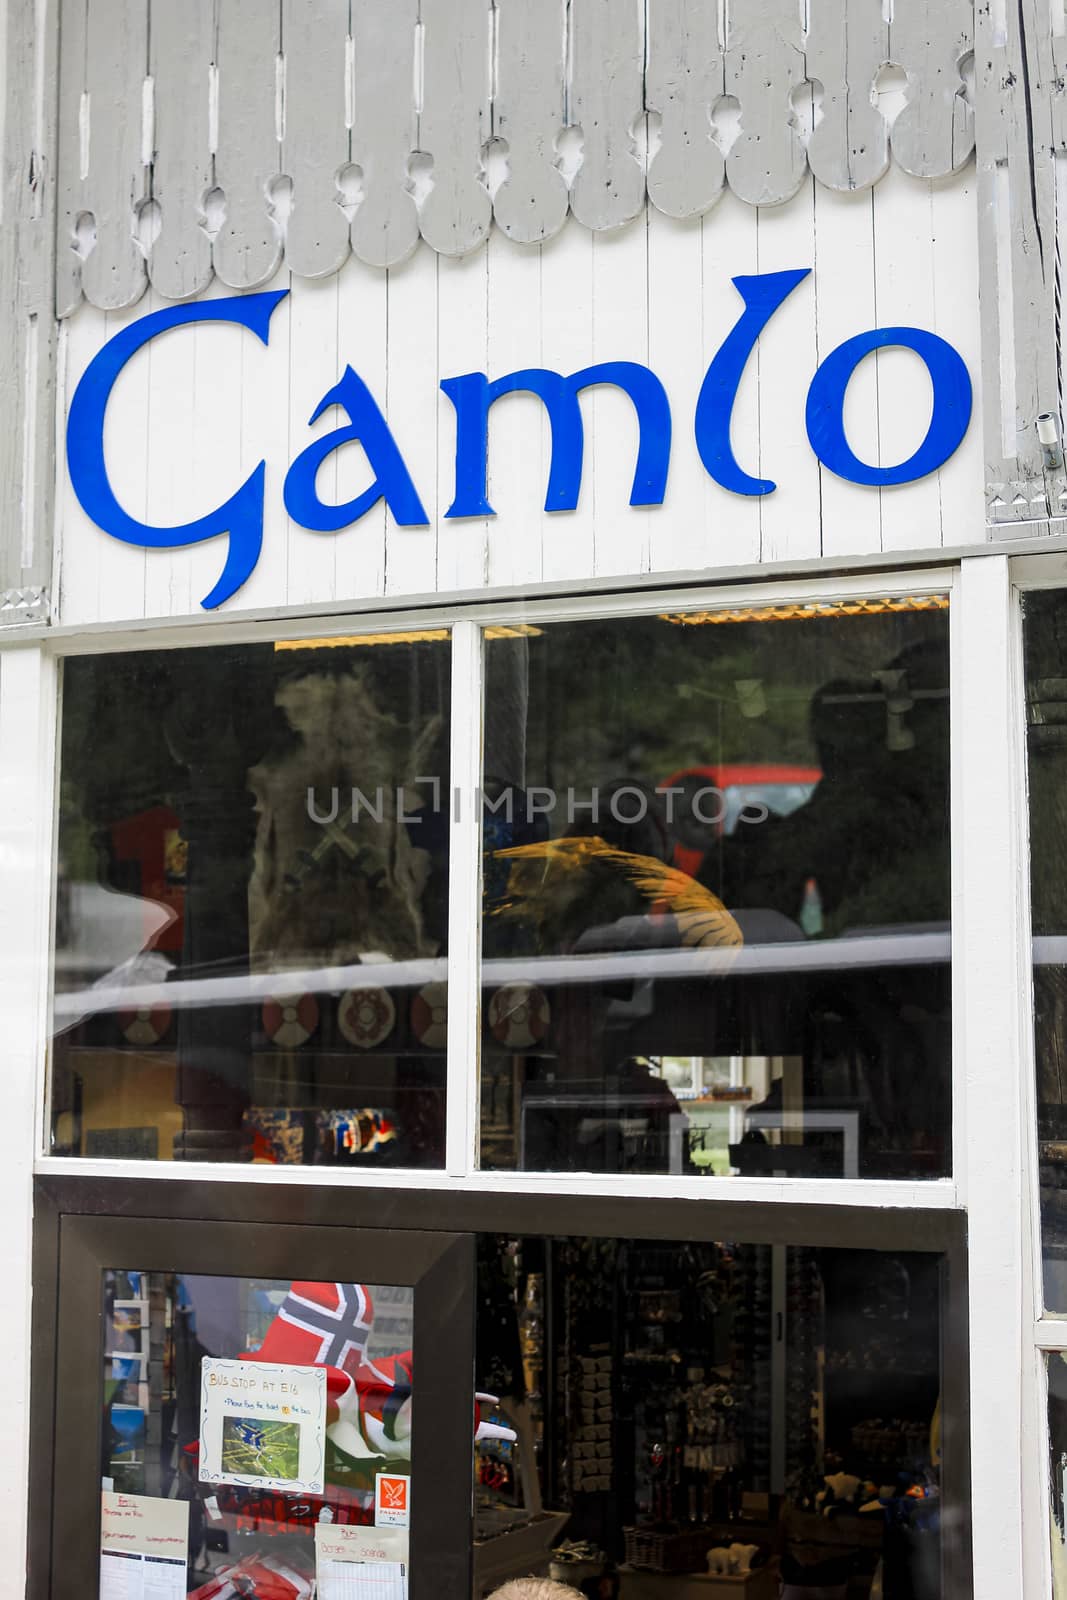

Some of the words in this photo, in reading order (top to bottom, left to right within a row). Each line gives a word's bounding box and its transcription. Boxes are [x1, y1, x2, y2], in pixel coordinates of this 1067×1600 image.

[66, 268, 972, 610] Gamlo
[231, 1377, 256, 1389] STOP
[262, 1381, 276, 1392] AT
